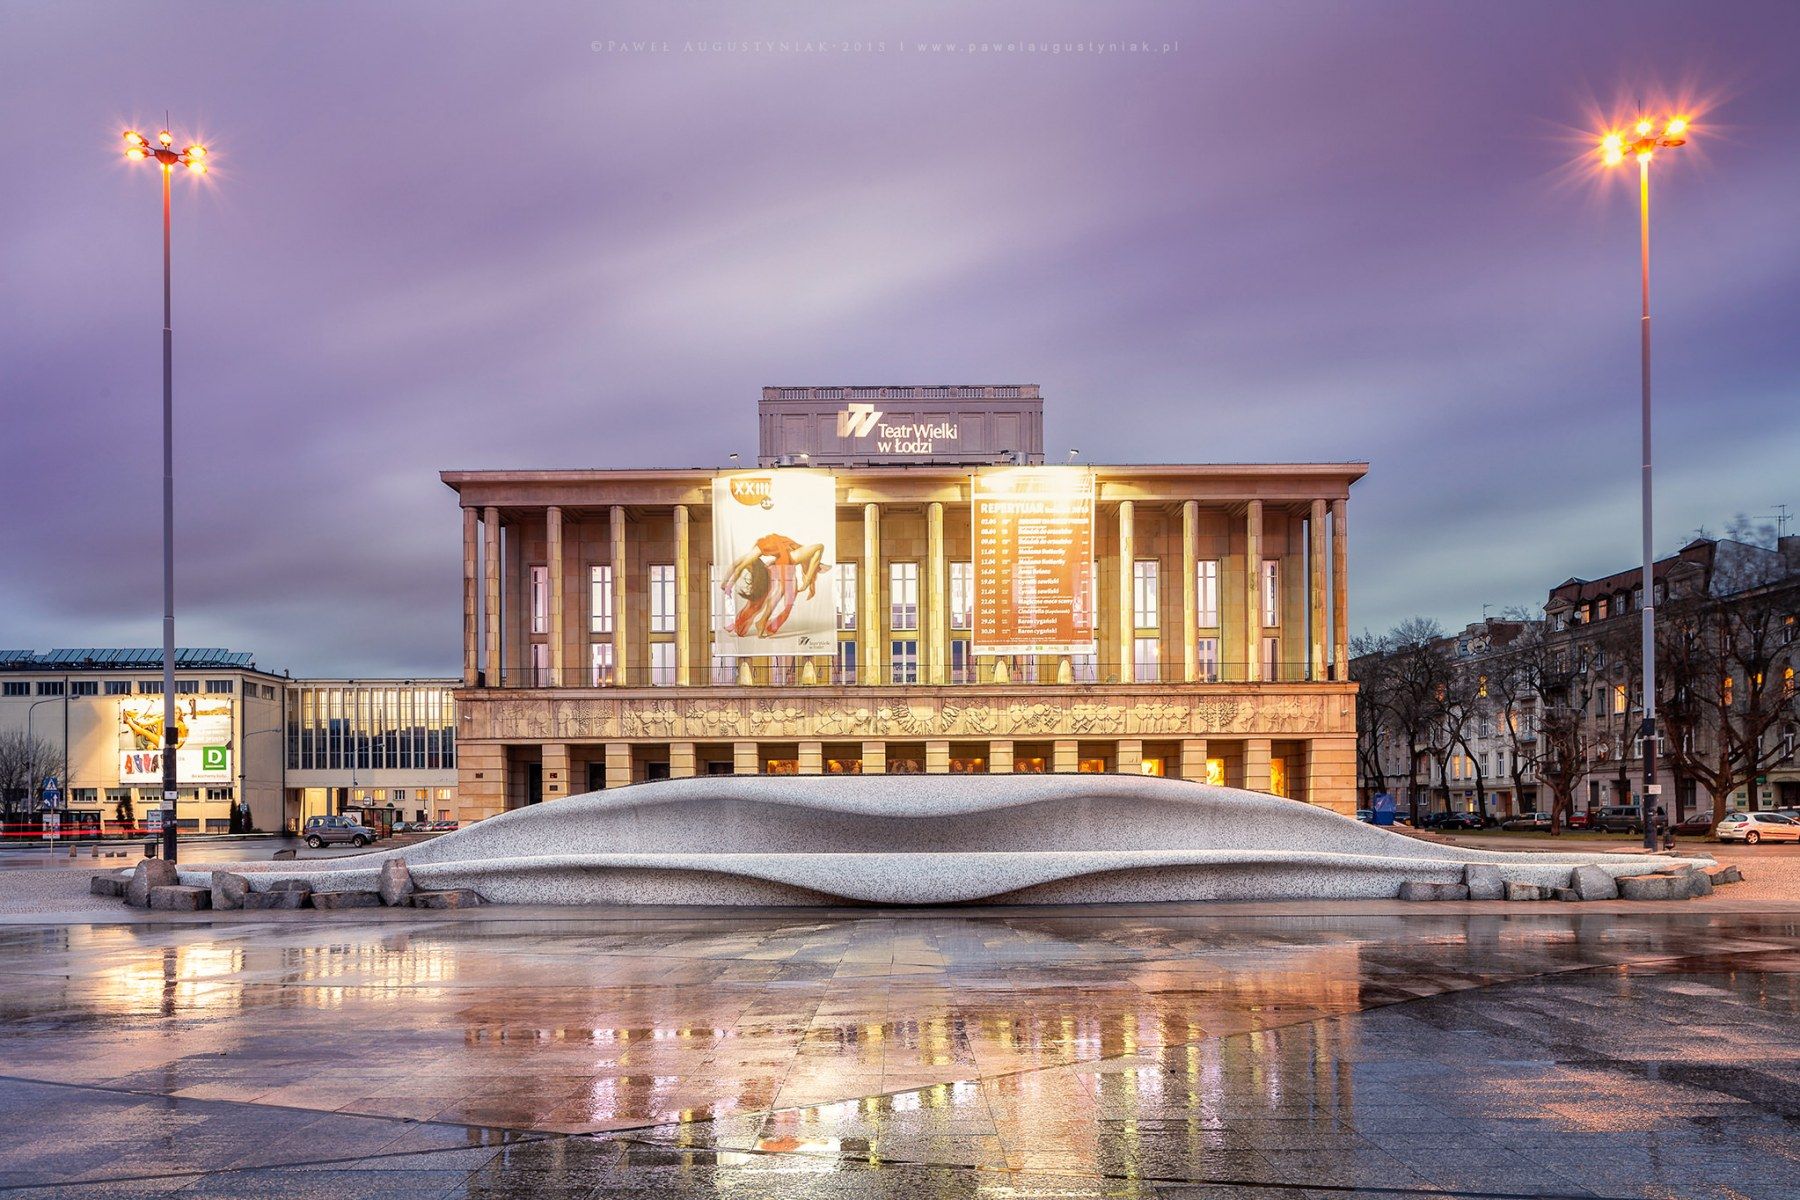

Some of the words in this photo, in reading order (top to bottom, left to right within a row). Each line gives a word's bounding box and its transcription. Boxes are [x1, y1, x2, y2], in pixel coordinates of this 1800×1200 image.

[878, 424, 913, 438] Teatr
[913, 423, 958, 439] Wielki
[878, 441, 893, 453] w
[895, 439, 932, 454] Łodzi
[208, 750, 222, 764] D
